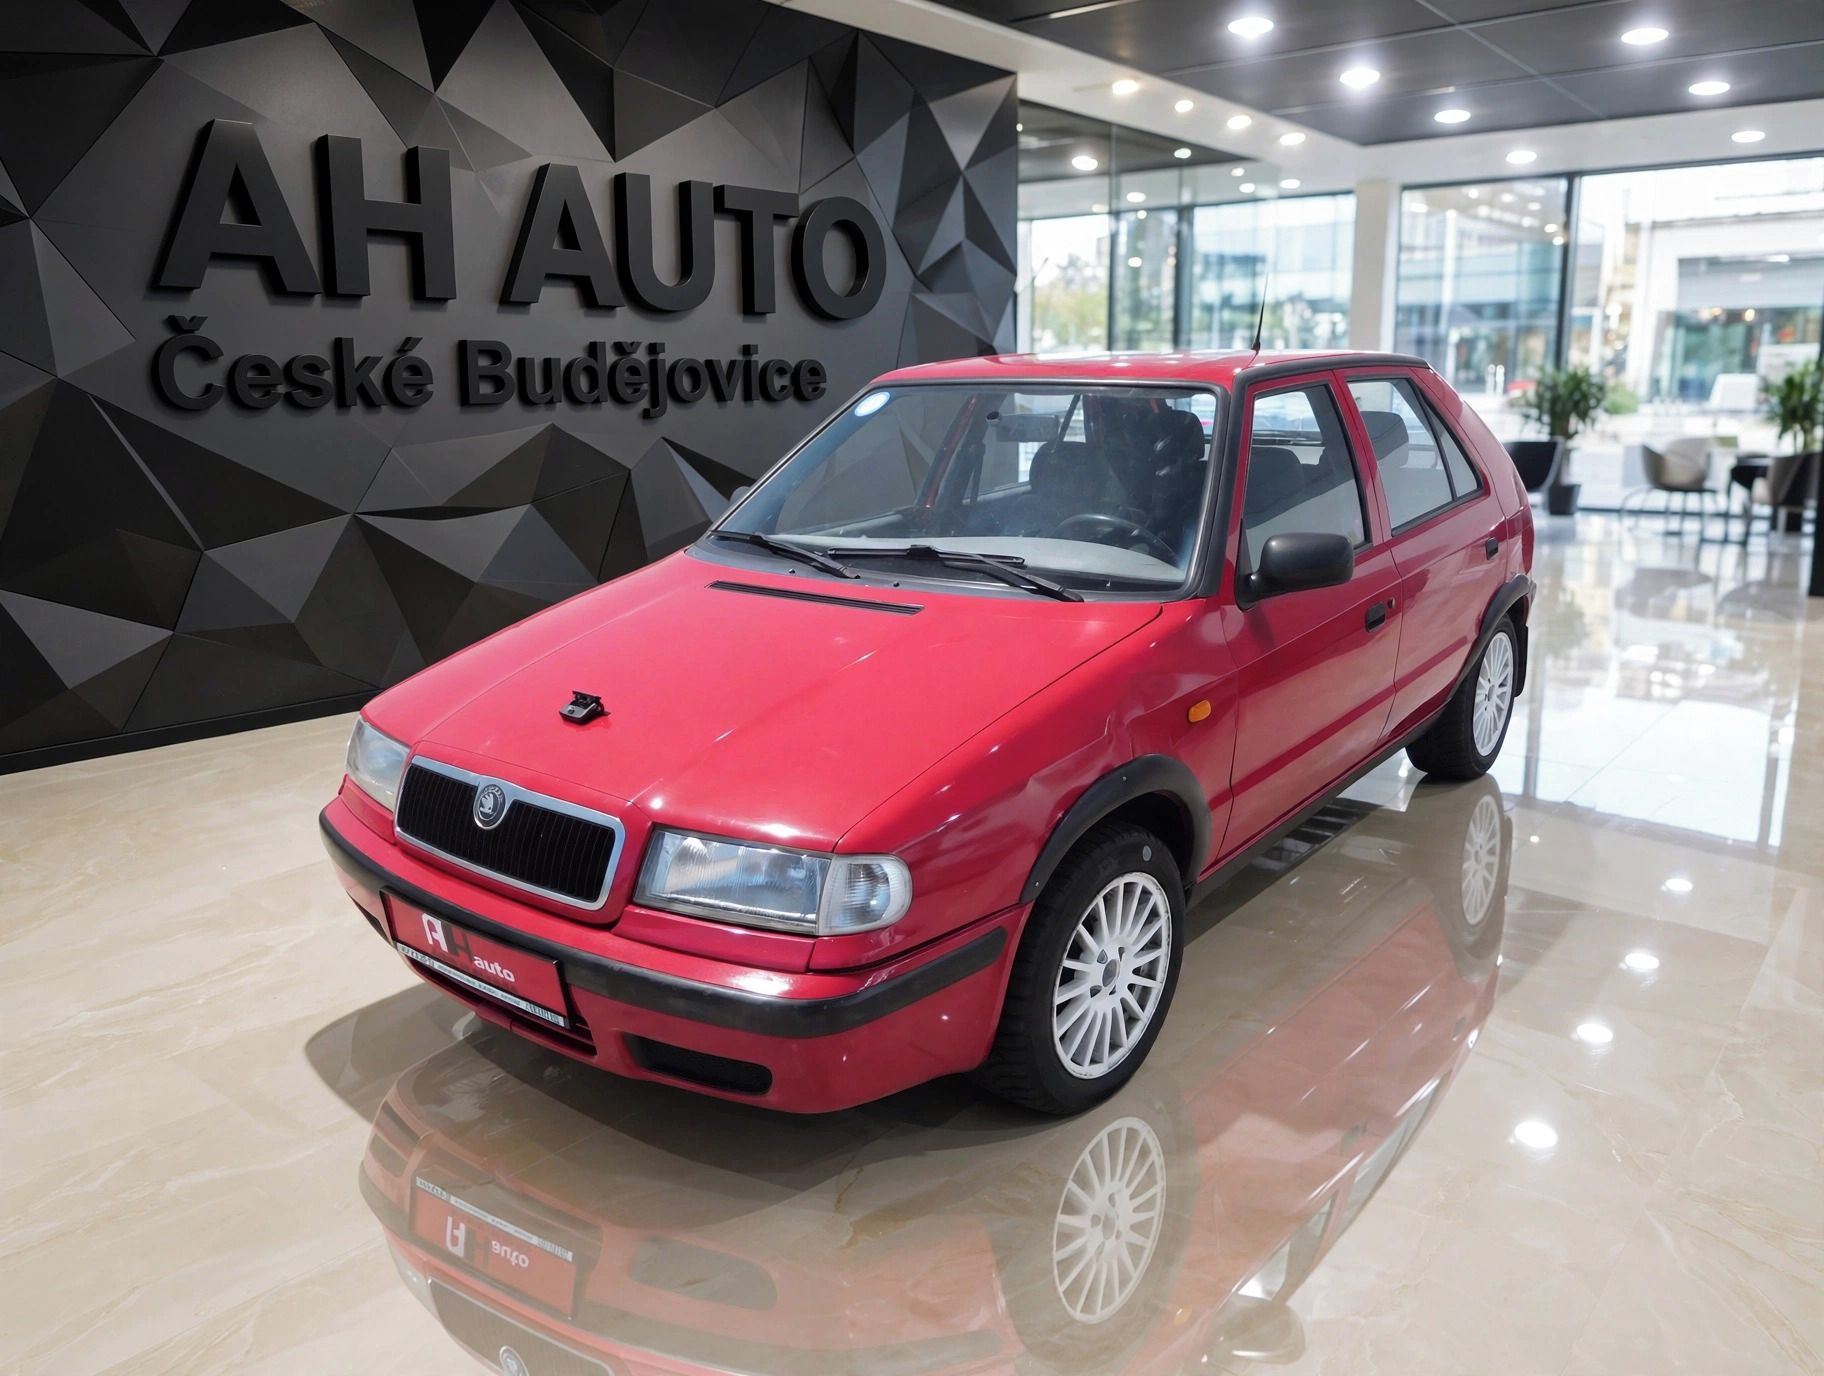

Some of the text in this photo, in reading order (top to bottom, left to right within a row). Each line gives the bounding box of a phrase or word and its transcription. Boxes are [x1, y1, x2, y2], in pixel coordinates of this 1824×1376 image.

[151, 118, 887, 320] AH AUTO
[151, 314, 827, 419] České Budějovice
[473, 955, 516, 983] auto
